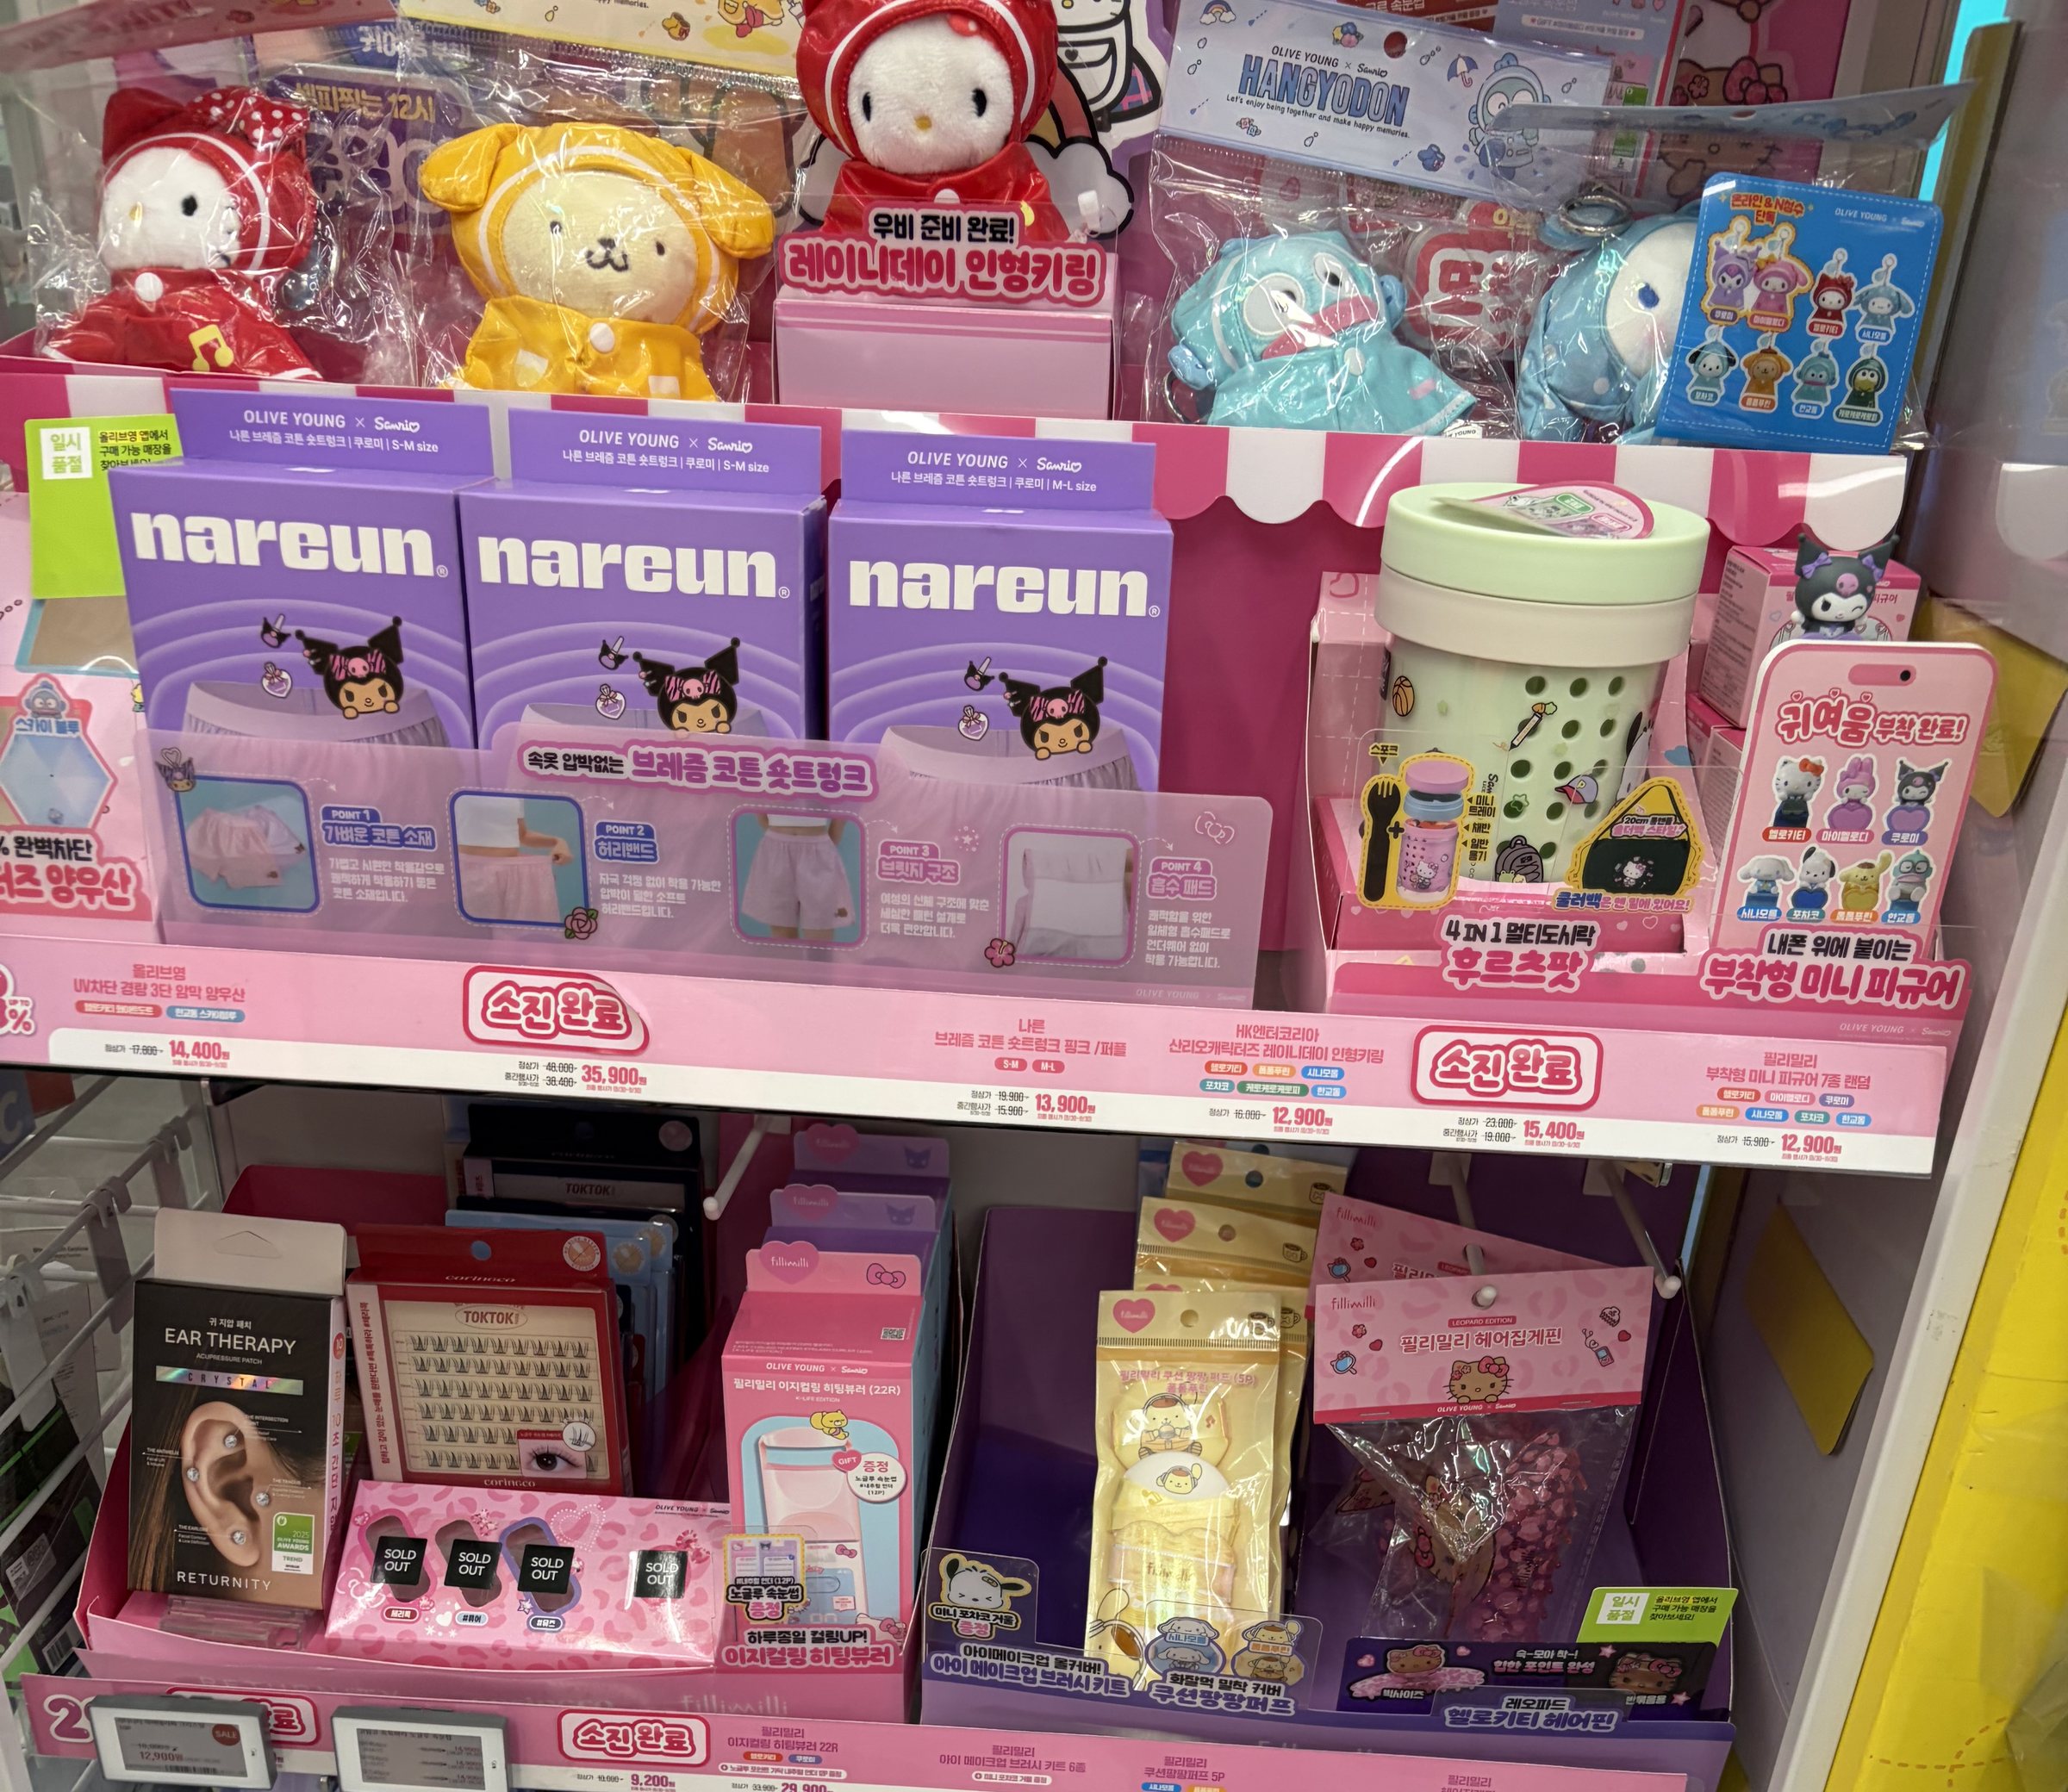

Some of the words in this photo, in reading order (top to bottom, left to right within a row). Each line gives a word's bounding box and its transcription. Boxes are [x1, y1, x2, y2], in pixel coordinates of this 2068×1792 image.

[1272, 46, 1302, 59] OLIVE
[1305, 50, 1339, 68] YOUNG
[1238, 54, 1410, 127] HANGYODON
[1226, 93, 1243, 104] Let's
[1246, 98, 1265, 109] enjoy
[1266, 102, 1285, 114] being
[1286, 106, 1317, 119] together
[1318, 113, 1330, 122] and
[1333, 115, 1351, 127] make
[1354, 121, 1374, 133] happy
[1377, 125, 1410, 138] memories.
[873, 214, 914, 240] 우비
[921, 215, 962, 242] 준비
[967, 217, 1014, 243] 완료!
[789, 242, 956, 289] 레이니데이
[965, 249, 1096, 296] 인형키링
[50, 432, 81, 450] 일시
[99, 431, 137, 441] 올리브영
[140, 429, 168, 441] 앱에서
[229, 431, 249, 443] 나른
[252, 432, 283, 445] 브레즘
[285, 433, 304, 445] 코튼
[307, 434, 346, 447] 숏트렁크
[353, 439, 384, 451] 쿠로미
[392, 440, 414, 451] S-M
[417, 441, 439, 453] size
[100, 445, 118, 456] 구매
[121, 445, 140, 456] 가능
[143, 444, 171, 455] 매장을
[51, 456, 83, 473] 품절
[564, 450, 582, 463] 나른
[585, 451, 614, 464] 브레즘
[617, 453, 636, 466] 코튼
[639, 455, 678, 468] 숏트렁크
[686, 457, 715, 470] 쿠로미
[724, 459, 745, 472] S-M
[748, 461, 769, 473] size
[892, 471, 911, 484] 나른
[913, 472, 943, 485] 브레즘
[945, 474, 965, 486] 코튼
[968, 475, 1006, 488] 숏트렁크
[1015, 477, 1043, 489] 쿠로미
[1053, 480, 1073, 491] M-L
[1076, 481, 1097, 492] size
[130, 513, 434, 576] nareun
[477, 536, 776, 598] nareun
[850, 560, 1149, 616] nareun
[1781, 699, 1871, 744] 귀여움
[1877, 717, 1912, 740] 부착
[1918, 719, 1965, 740] 완료!
[1371, 744, 1398, 756] 스포크
[528, 751, 558, 769] 속옷
[563, 754, 624, 774] 압박없는
[632, 751, 707, 783] 브레즘
[713, 756, 763, 787] 코튼
[768, 759, 868, 793] 숏트렁크
[1476, 795, 1494, 806] 미니
[332, 811, 360, 819] POINT
[606, 825, 634, 835] POINT
[638, 825, 645, 836] 2
[1891, 833, 1919, 843] 쿠로미
[14, 836, 93, 862] 완벽차단
[890, 846, 919, 855] POINT
[922, 846, 929, 856] 3
[1162, 862, 1191, 871] POINT
[1193, 862, 1202, 872] 4
[46, 864, 131, 905] 양우산
[1446, 920, 1461, 941] 4
[1463, 924, 1486, 942] IN
[1491, 923, 1501, 943] 1
[1505, 923, 1595, 946] 멀티도시락
[1767, 933, 1807, 955] 내폰
[1811, 936, 1850, 958] 위에
[1853, 937, 1911, 961] 붙이는
[133, 965, 186, 980] 올리브영
[1448, 947, 1583, 988] 후르츠팟
[1705, 958, 1797, 999] 부착형
[1800, 963, 1864, 999] 미니
[1866, 967, 1959, 1006] 피규어
[1019, 1019, 1044, 1034] 나른
[1236, 1025, 1319, 1042] HK엔터코리아
[1169, 1039, 1259, 1058] 산리오캐릭터즈
[1263, 1043, 1328, 1061] 레이니데이
[1331, 1048, 1384, 1064] 인형키링
[1003, 1060, 1018, 1068] S-M
[1041, 1061, 1056, 1071] M-L
[1764, 1053, 1817, 1068] 필리밀리
[1706, 1067, 1746, 1083] 부착형
[1749, 1070, 1775, 1084] 미니
[1778, 1072, 1818, 1086] 피규어
[1822, 1073, 1841, 1088] 7종
[1845, 1075, 1871, 1089] 랜덤
[566, 1183, 611, 1195] TOKTOK
[771, 1257, 808, 1267] fillimilli
[1331, 1296, 1375, 1310] fillimilli
[219, 1319, 234, 1328] 지압
[236, 1321, 252, 1330] 패치
[464, 1310, 514, 1324] TOKTOK
[165, 1328, 202, 1346] EAR
[207, 1332, 296, 1354] THERAPY
[1401, 1333, 1470, 1353] 필리밀리
[1475, 1328, 1561, 1347] 헤어집게핀
[196, 1353, 241, 1363] ACUPRESSURE
[189, 1373, 269, 1389] CRYSTAL
[734, 1378, 776, 1391] 필리밀리
[779, 1381, 820, 1392] 이지컬링
[824, 1383, 866, 1395] 히팅뷰러
[869, 1385, 900, 1396] (22R)
[863, 1461, 888, 1472] 증정
[384, 1548, 416, 1561] SOLD
[458, 1552, 490, 1564] SOLD
[385, 1561, 411, 1572] OUT
[458, 1564, 486, 1576] OUT
[531, 1556, 564, 1569] SOLD
[645, 1561, 678, 1574] SOLD
[178, 1571, 271, 1590] RETURNITY
[532, 1569, 558, 1581] OUT
[647, 1574, 674, 1585] OUT
[1612, 1596, 1640, 1607] 일시
[935, 1607, 956, 1617] 미니
[959, 1608, 992, 1621] 포차코
[1607, 1610, 1635, 1621] 품절
[748, 1631, 806, 1644] 하루종일
[811, 1631, 867, 1644] 컬링UP!
[726, 1647, 806, 1665] 이지컬링
[810, 1646, 890, 1664] 히팅뷰러
[934, 1656, 967, 1674] 아이
[971, 1661, 1037, 1684] 메이크업
[1040, 1669, 1089, 1690] 브러시
[1093, 1677, 1126, 1695] 키트
[1505, 1698, 1567, 1710] 레오파드
[1448, 1708, 1538, 1727] 헬로키티
[1543, 1711, 1616, 1730] 헤어핀
[215, 1730, 237, 1739] SALE
[819, 1742, 838, 1752] 22R
